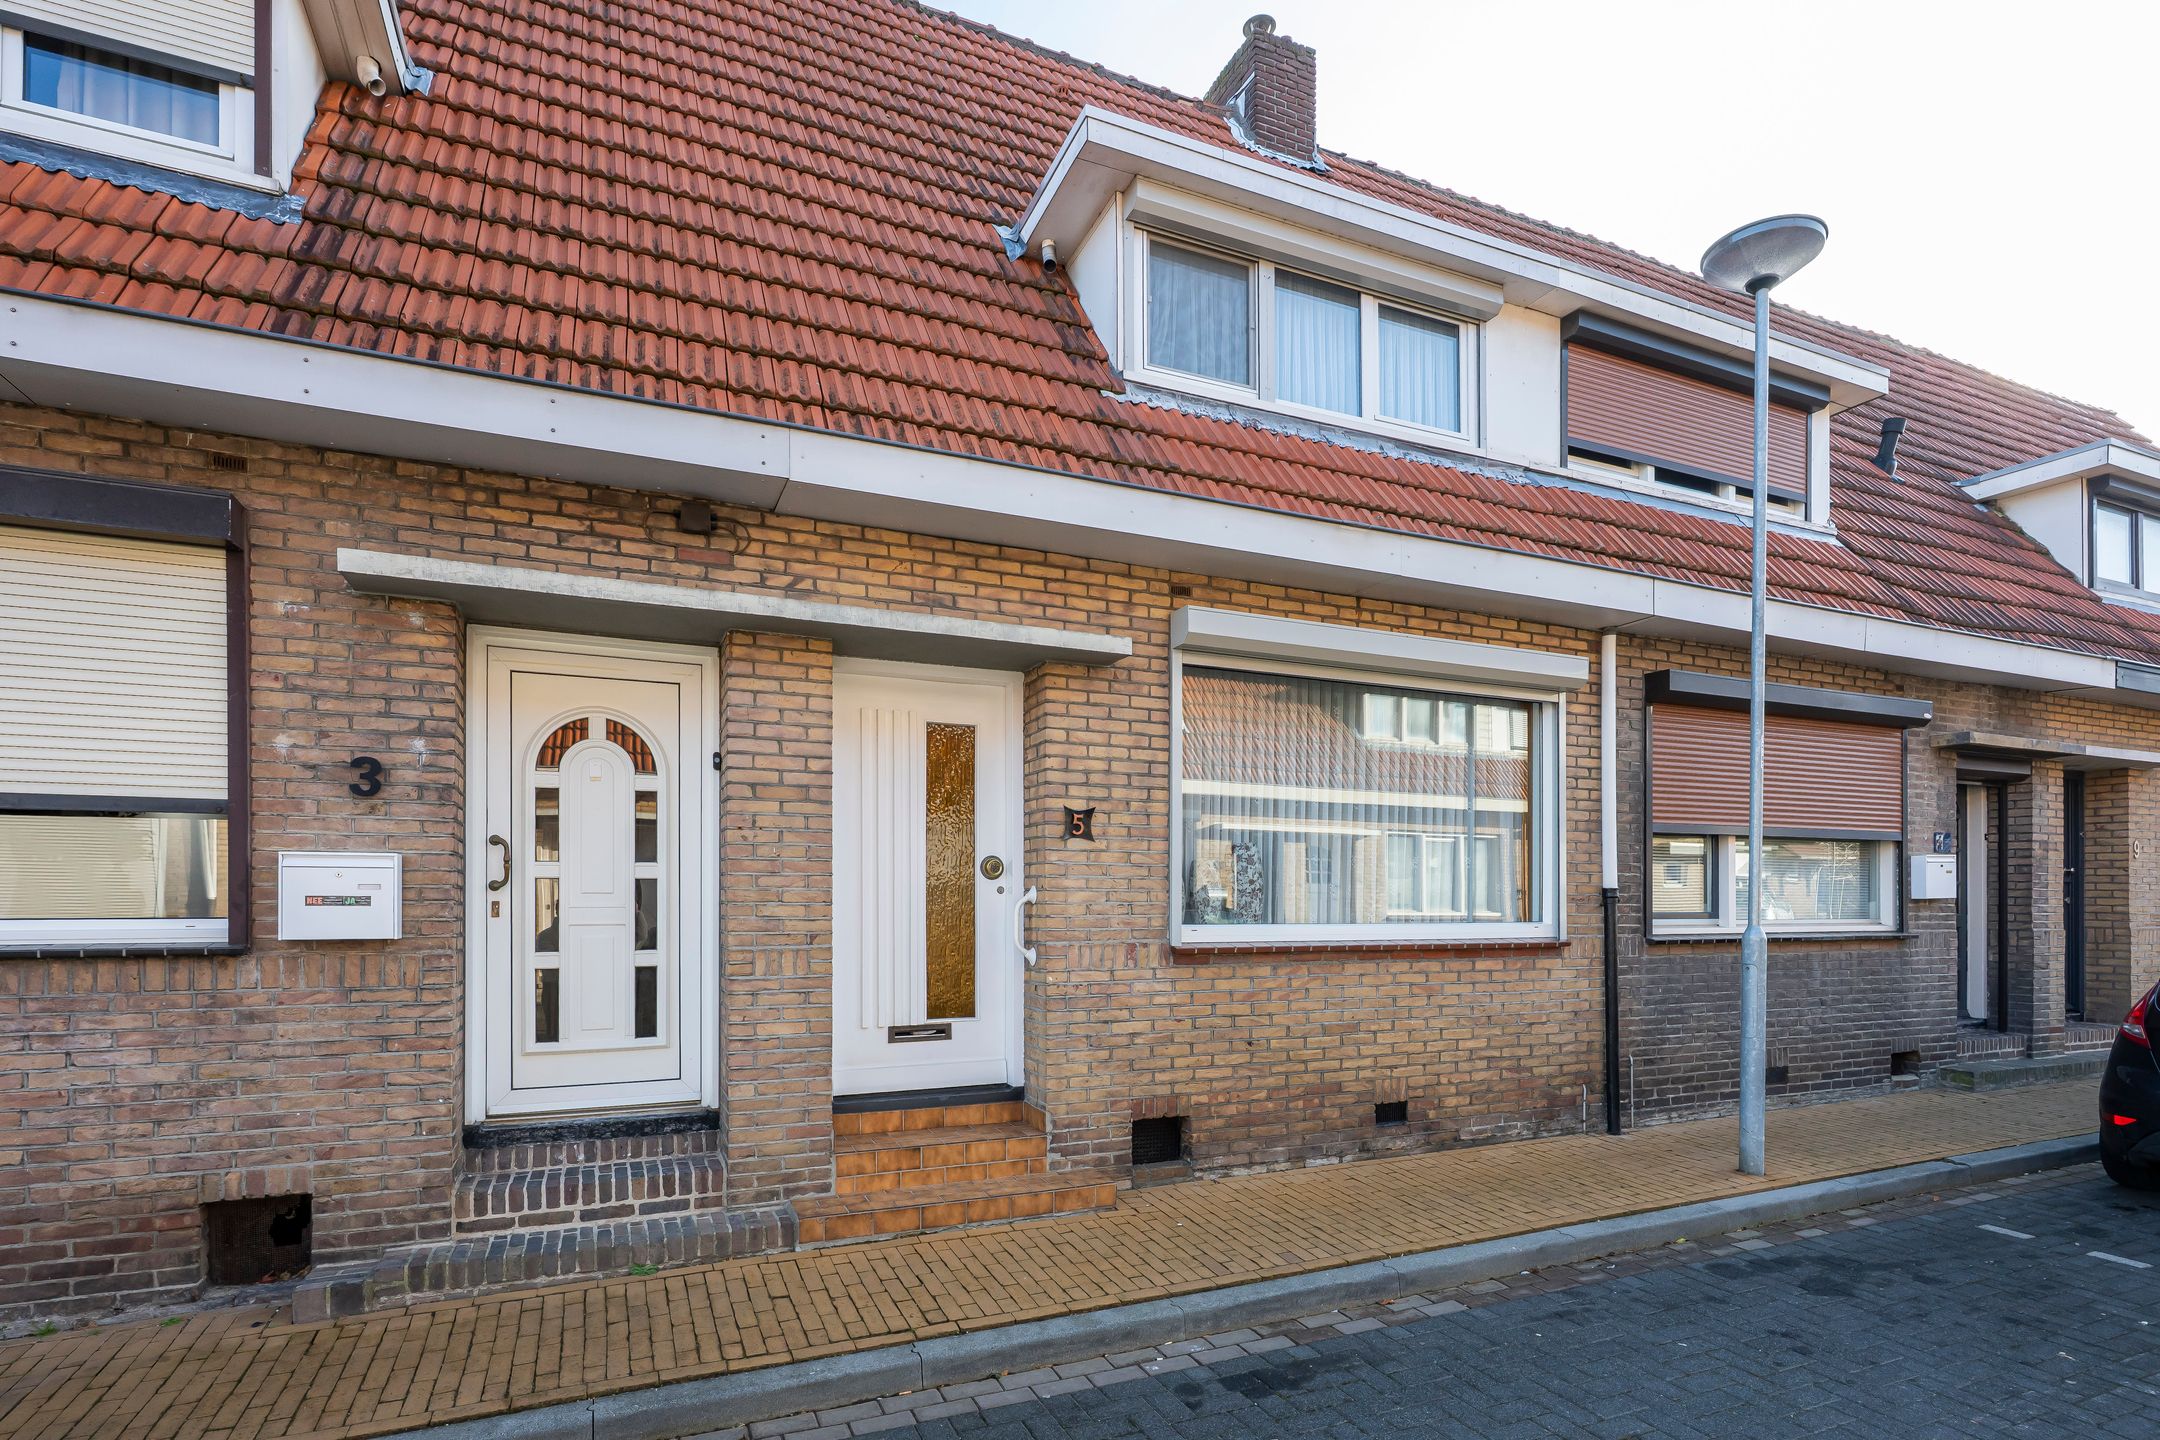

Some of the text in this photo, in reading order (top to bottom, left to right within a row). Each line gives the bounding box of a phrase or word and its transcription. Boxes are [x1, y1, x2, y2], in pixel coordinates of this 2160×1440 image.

[349, 756, 382, 797] 3
[1072, 813, 1085, 836] 5
[2133, 840, 2140, 859] 9
[306, 896, 323, 904] NEE
[345, 896, 356, 904] JA
